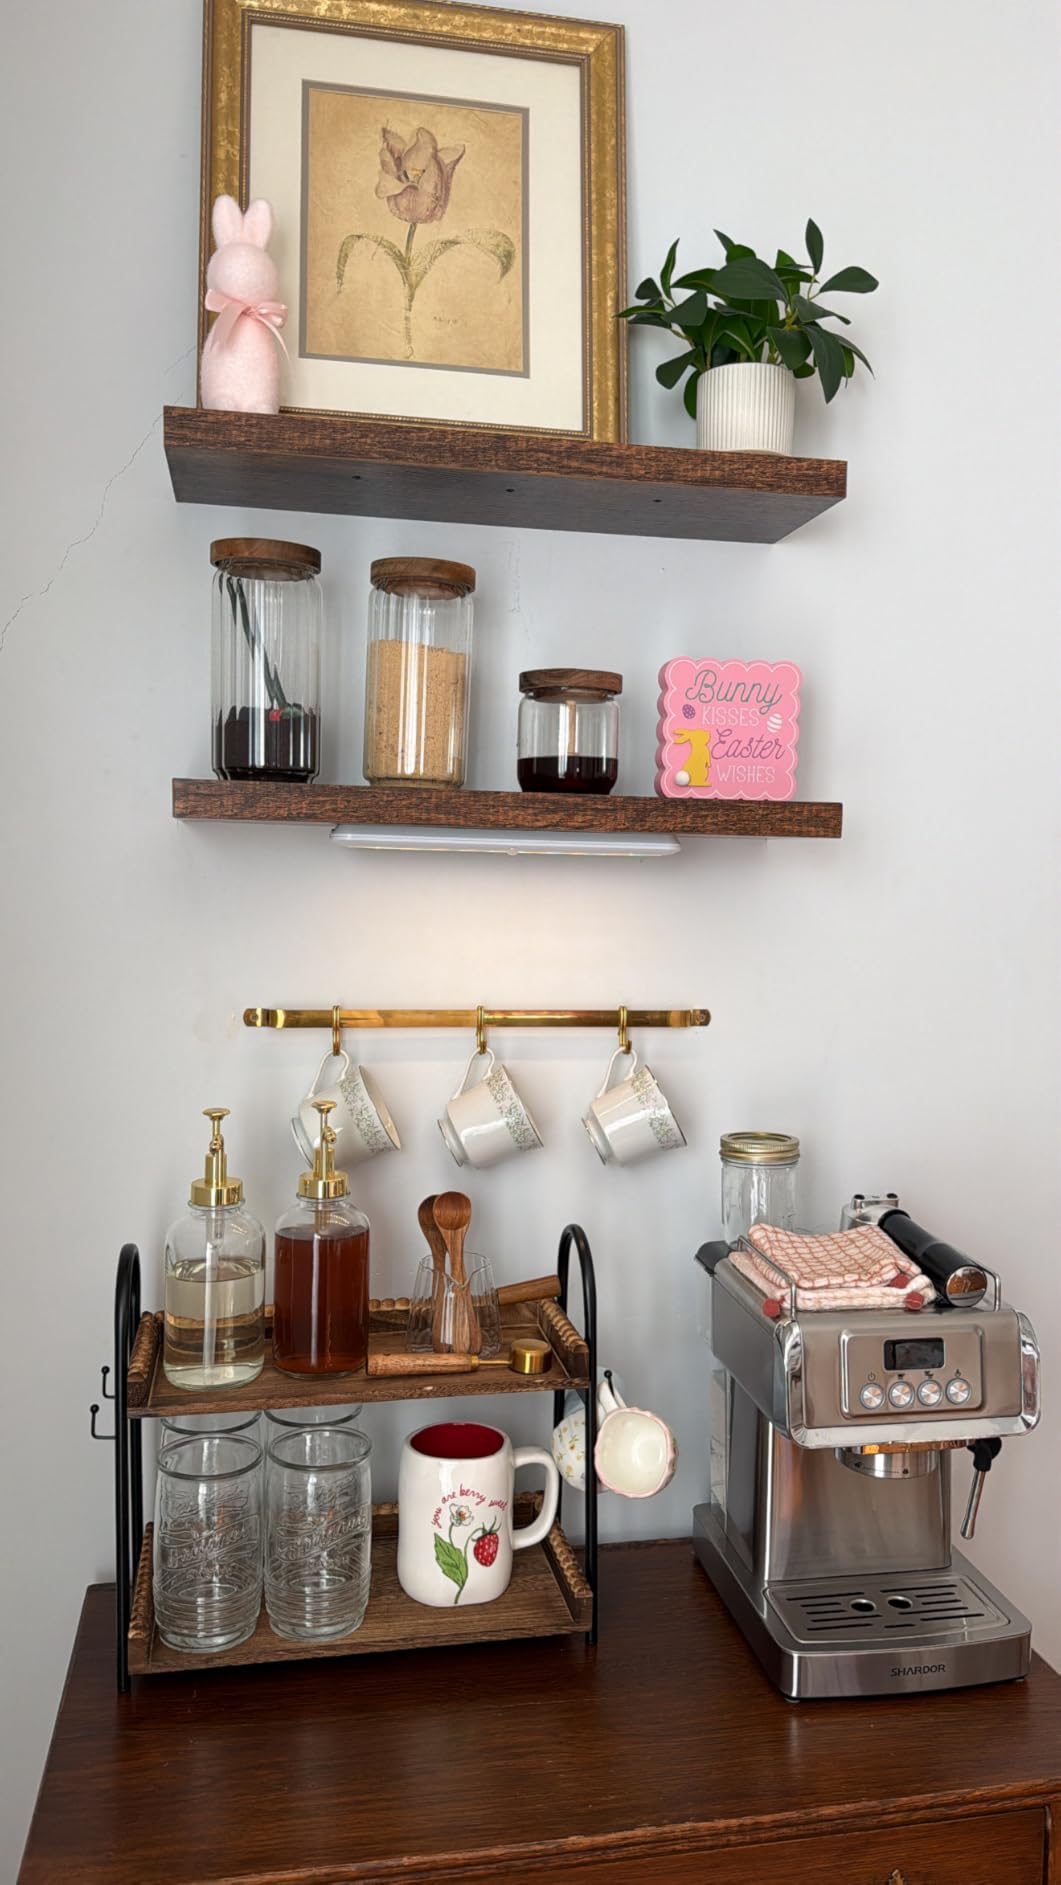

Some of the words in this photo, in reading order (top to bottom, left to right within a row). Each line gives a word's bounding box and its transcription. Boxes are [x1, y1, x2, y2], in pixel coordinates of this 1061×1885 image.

[685, 669, 783, 715] Bunny
[701, 706, 760, 727] KISSES
[711, 728, 785, 760] Easter
[716, 764, 776, 784] WISHES
[431, 1507, 442, 1528] you
[441, 1491, 456, 1504] are
[460, 1483, 486, 1505] berry
[890, 1664, 946, 1677] SHARDOR
